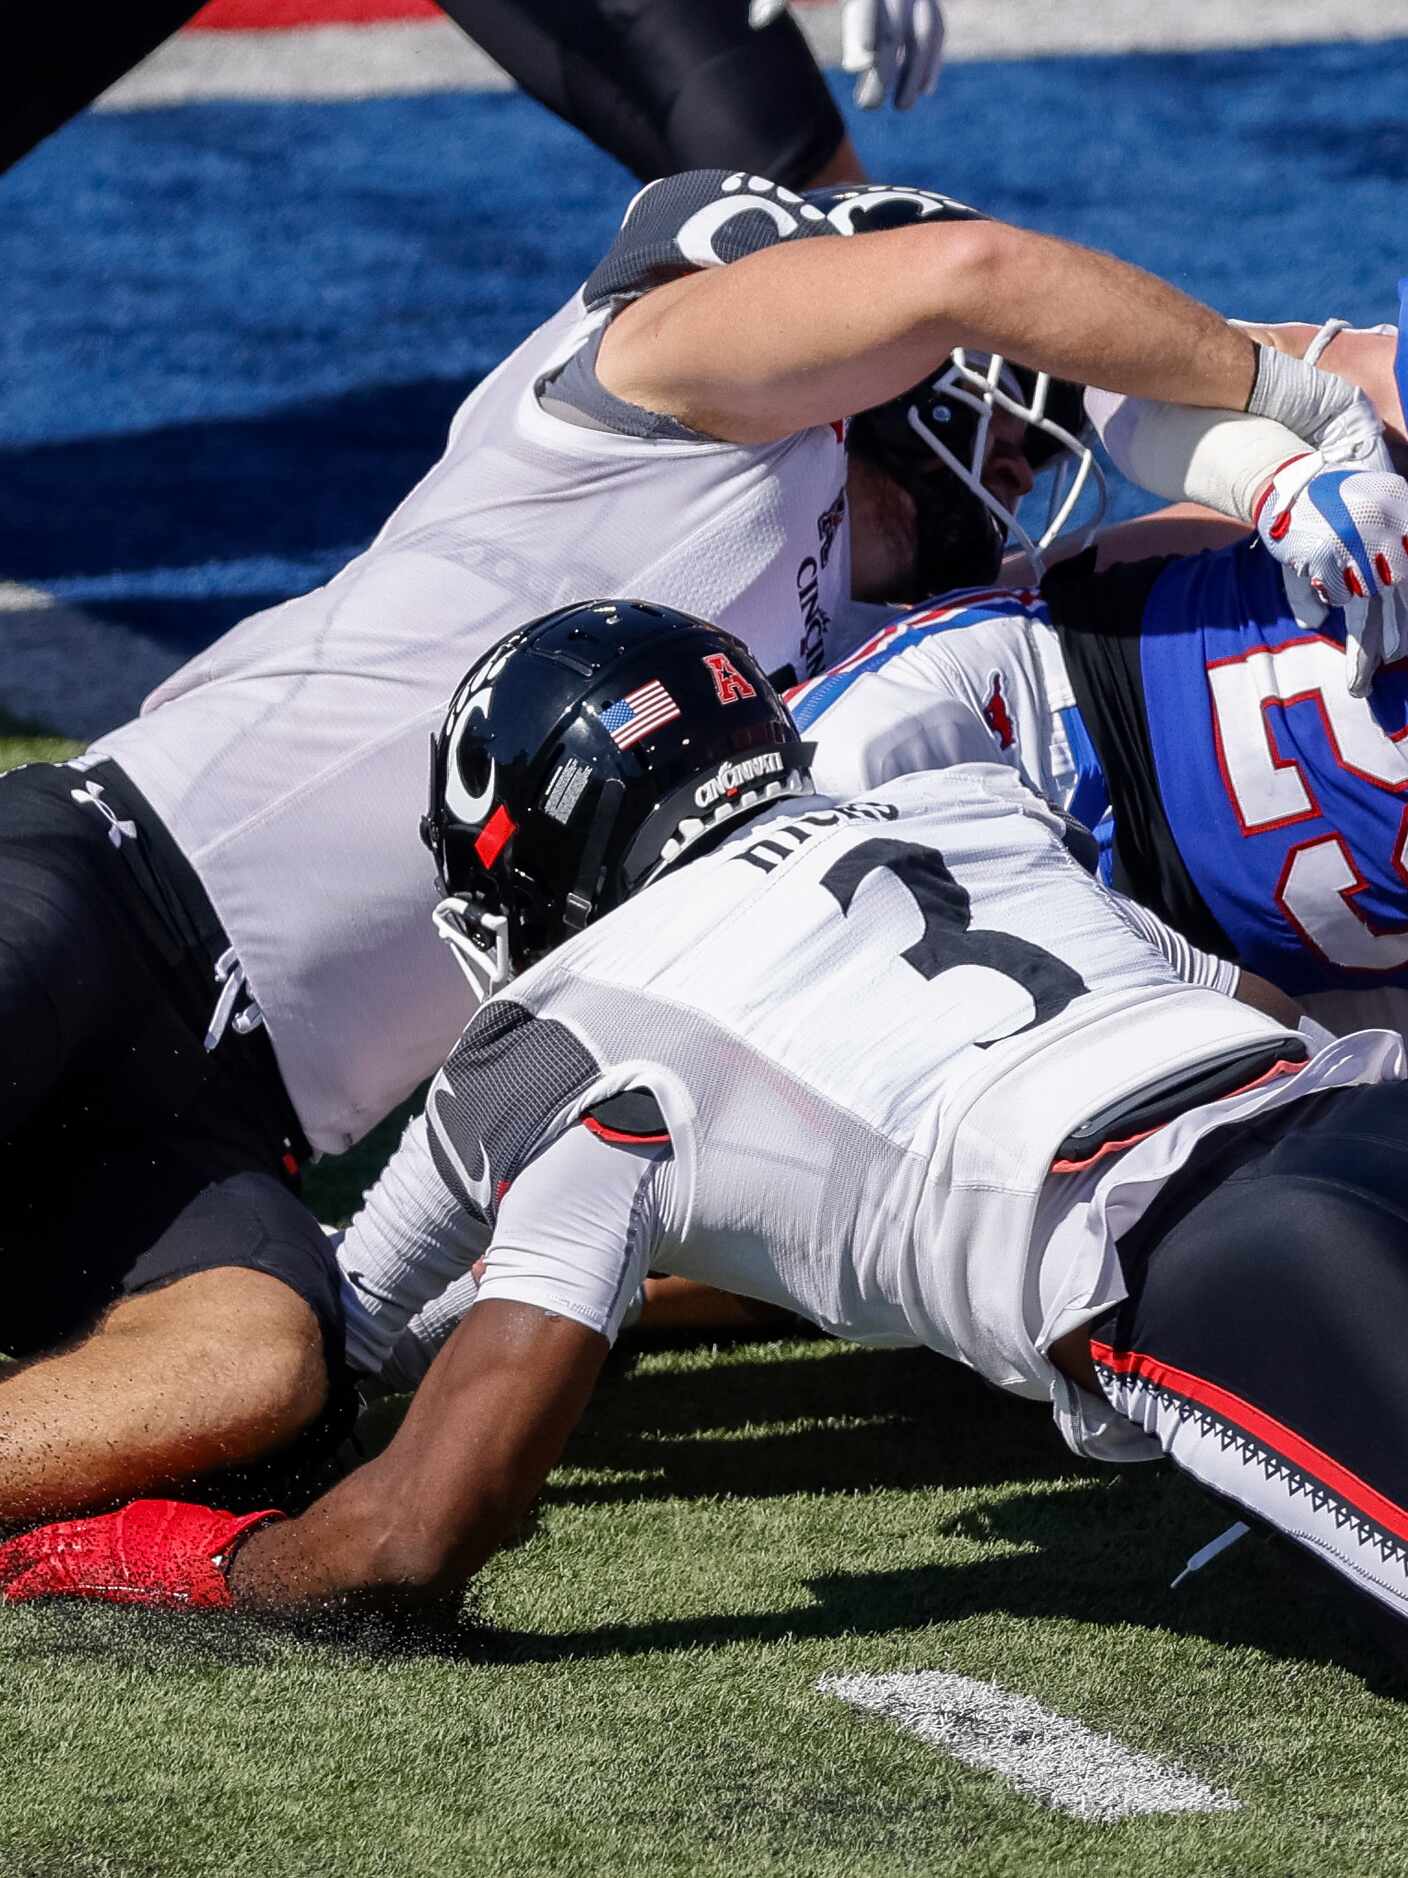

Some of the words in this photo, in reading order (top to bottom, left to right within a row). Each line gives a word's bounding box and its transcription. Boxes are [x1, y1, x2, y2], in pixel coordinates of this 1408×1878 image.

[797, 556, 830, 681] CINCIN
[703, 653, 757, 704] A
[695, 752, 784, 808] CINCINNATI
[819, 837, 1091, 1050] 3
